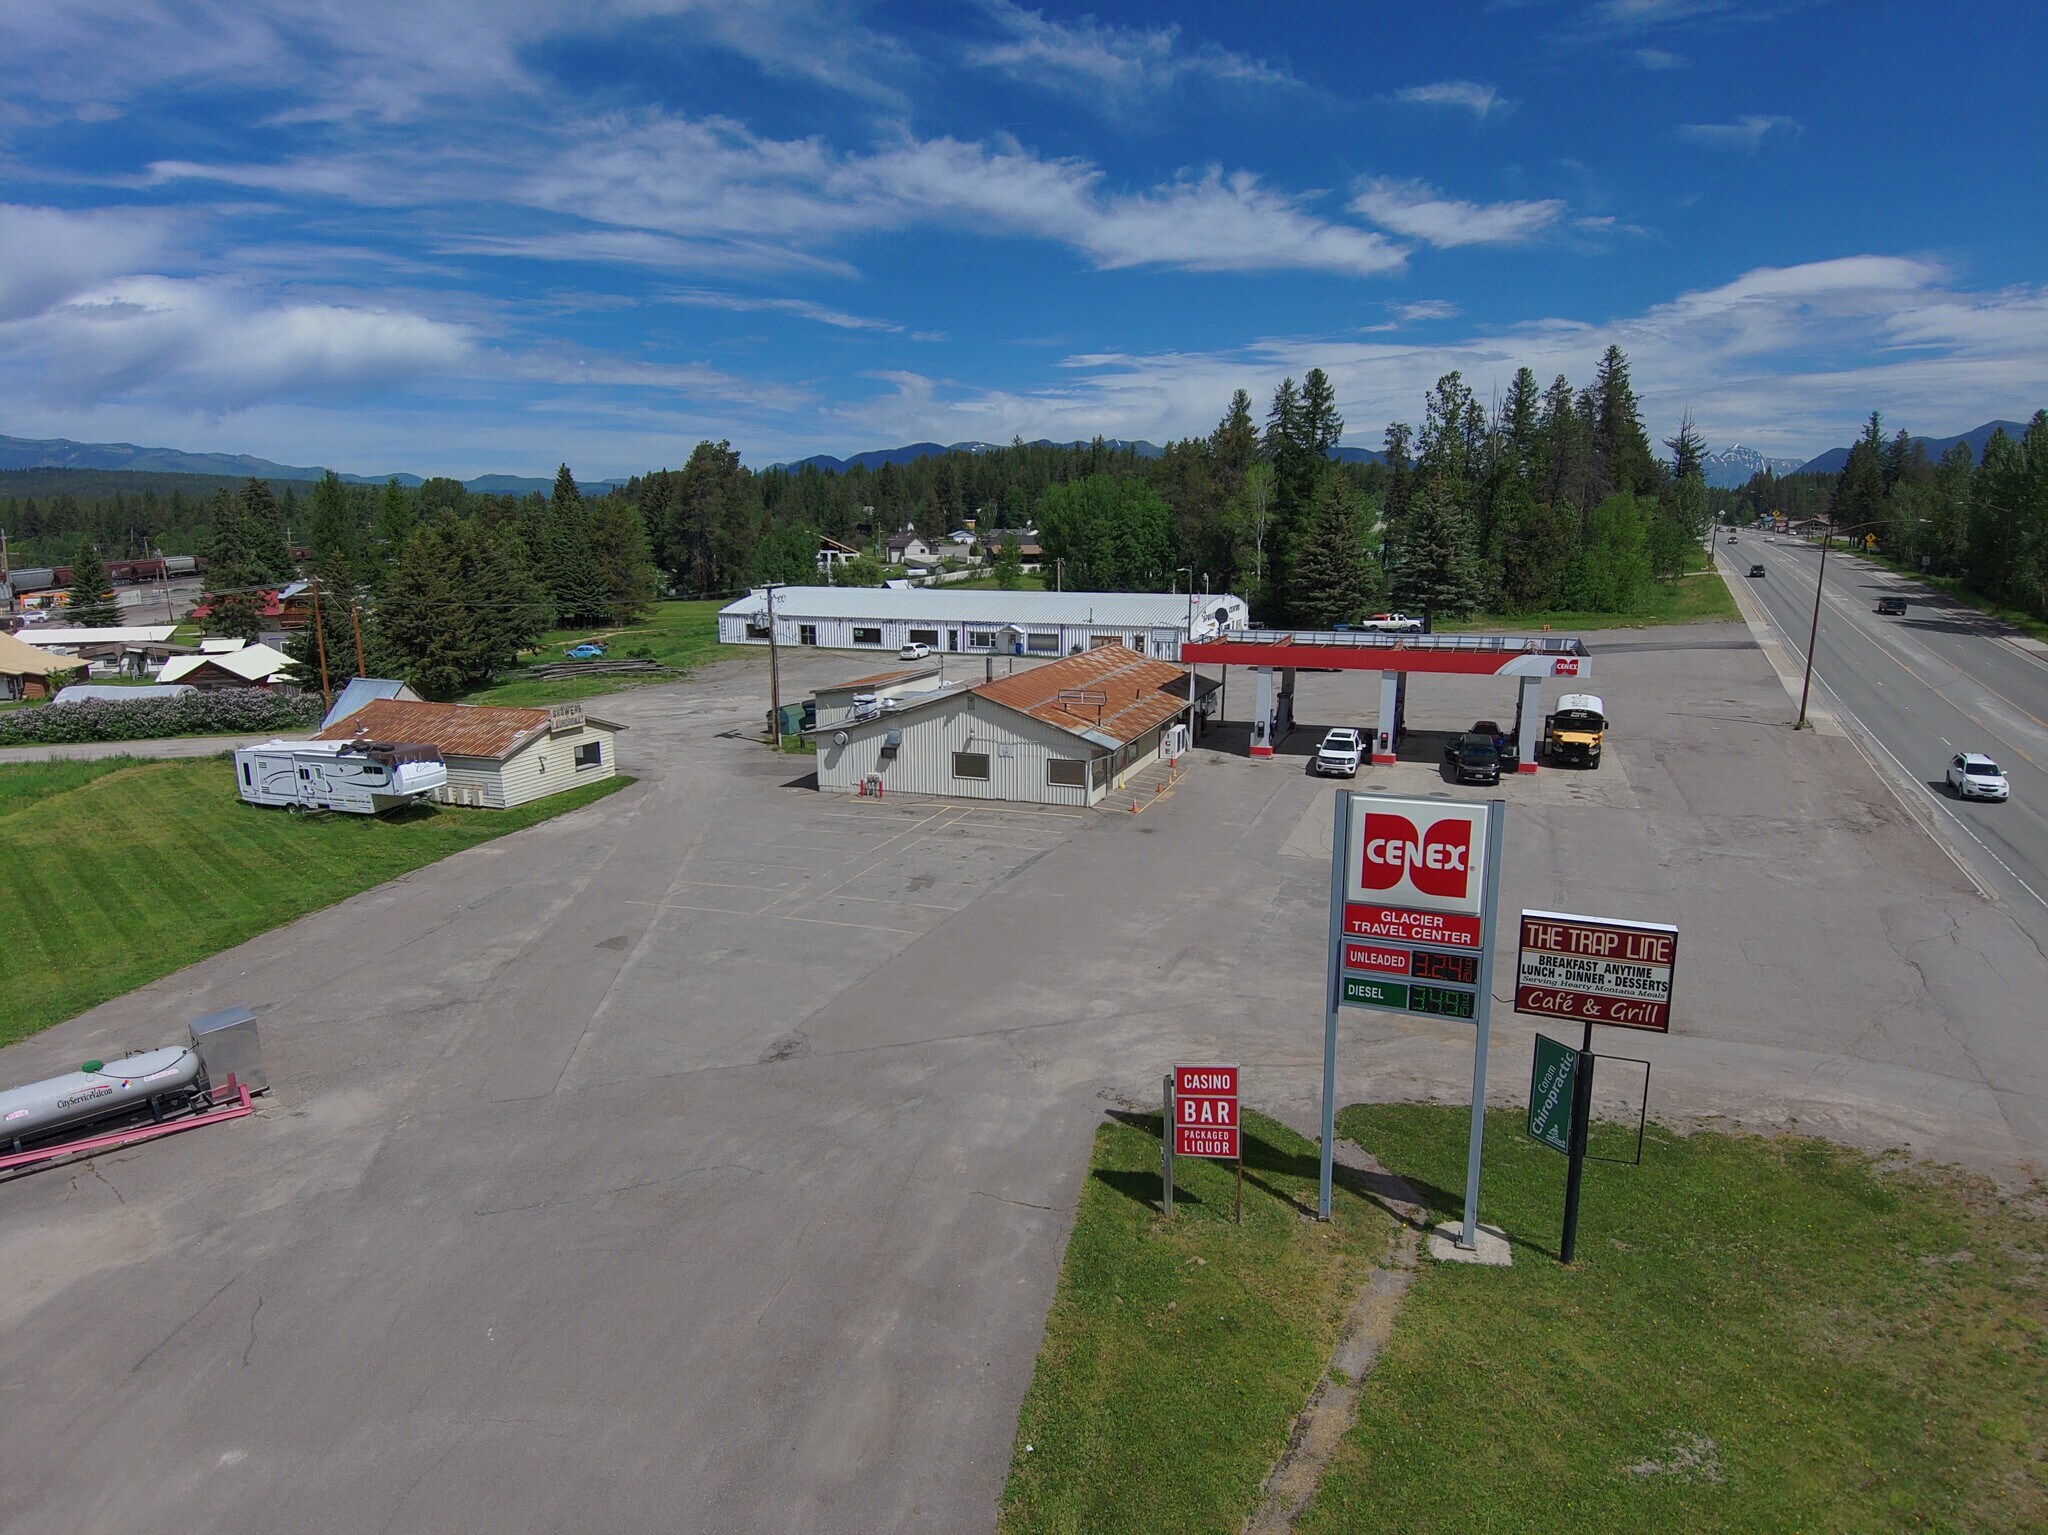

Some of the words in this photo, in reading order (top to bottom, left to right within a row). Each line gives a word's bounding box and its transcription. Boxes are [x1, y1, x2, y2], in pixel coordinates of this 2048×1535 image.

[1556, 662, 1578, 670] CENEX
[1366, 838, 1466, 871] CENEX
[1380, 911, 1443, 928] GLACIER
[1352, 921, 1407, 937] TRAVEL
[1411, 927, 1471, 944] CENTER
[1527, 924, 1563, 950] THE
[1568, 929, 1619, 956] TRAP
[1626, 935, 1670, 962] LINE
[1350, 950, 1405, 968] UNLEADED
[1538, 955, 1599, 972] BREAKFAST
[1604, 963, 1652, 979] ANYTIME
[1521, 964, 1555, 979] LUNCH
[1565, 970, 1605, 985] DINNER
[1615, 976, 1668, 992] DESSERTS
[1522, 975, 1558, 986] Serving
[1560, 980, 1592, 991] Hearty
[1594, 985, 1635, 996] Montana
[1637, 990, 1666, 999] Meals
[1348, 984, 1384, 999] DIESEL
[1527, 991, 1573, 1012] Café
[1582, 998, 1602, 1015] &
[1610, 1002, 1658, 1023] Grill
[1184, 1074, 1231, 1089] CASINO
[1538, 1064, 1556, 1094] Coram
[56, 1087, 113, 1109] CityServiceValcon
[1532, 1052, 1574, 1135] Chiropractic
[1184, 1100, 1230, 1123] BAR
[1184, 1130, 1229, 1140] PACKAGED
[1184, 1140, 1230, 1154] LIQUOR
